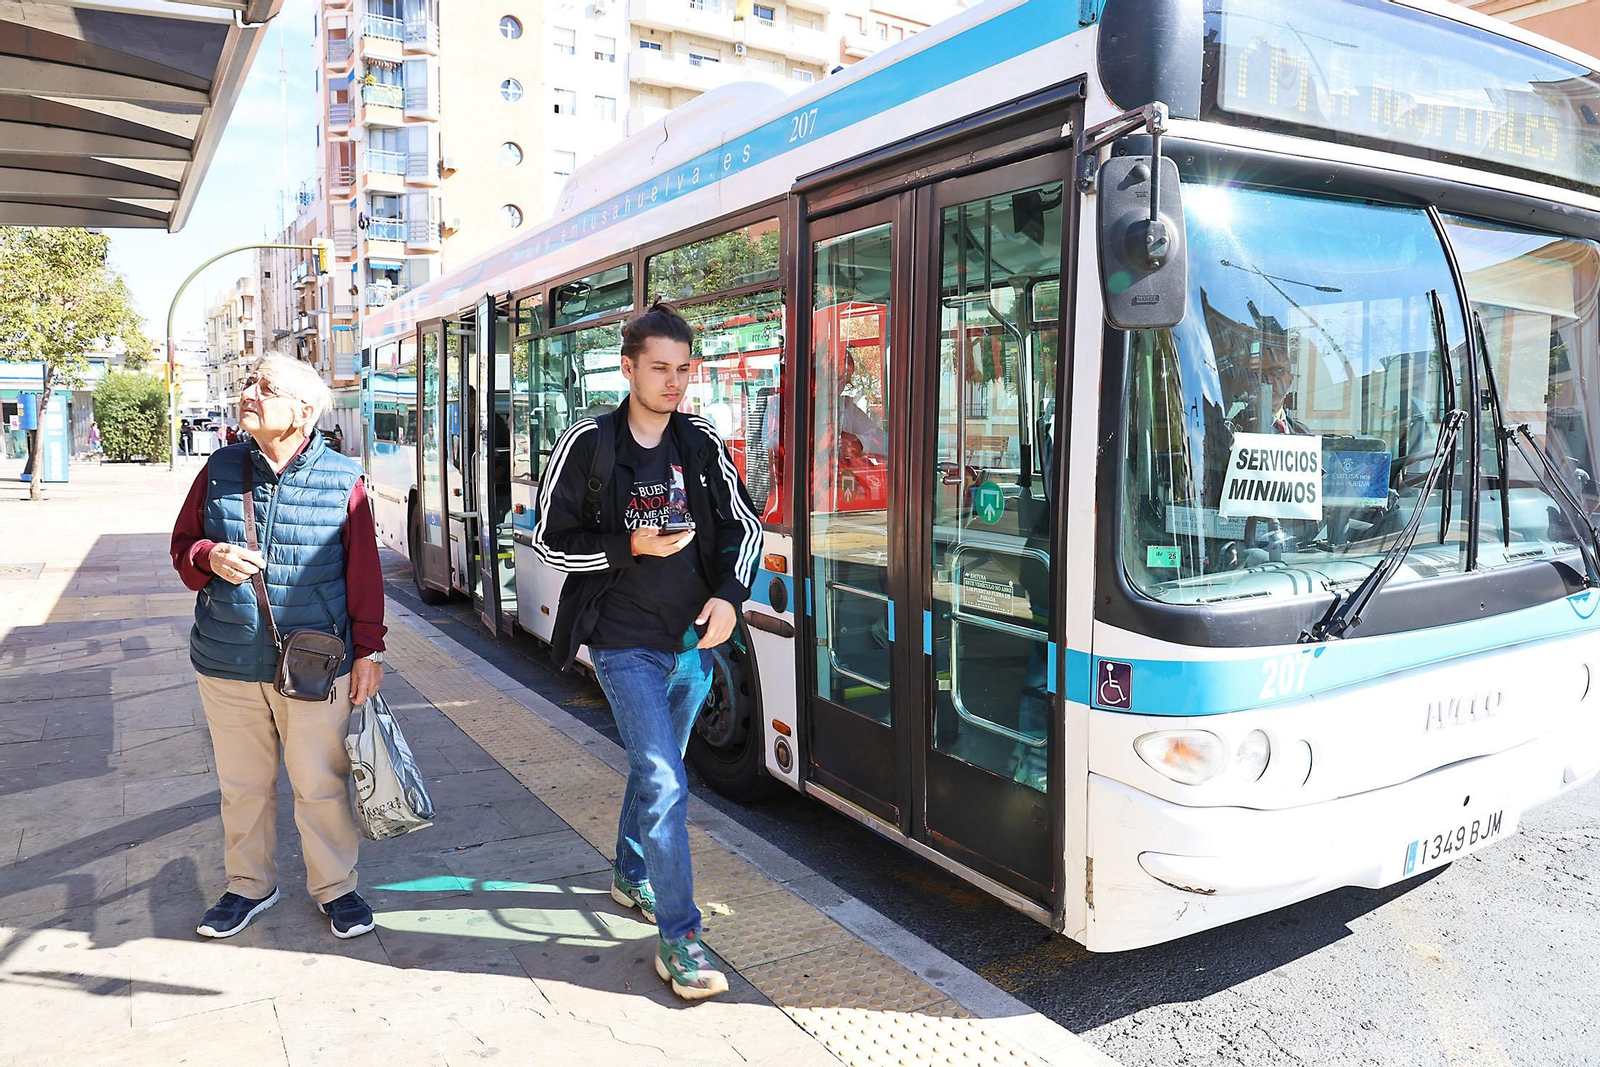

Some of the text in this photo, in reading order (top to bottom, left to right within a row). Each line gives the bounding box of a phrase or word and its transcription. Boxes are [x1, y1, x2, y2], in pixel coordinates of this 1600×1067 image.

[789, 107, 819, 143] 207
[1235, 448, 1318, 473] SERVICIOS
[1228, 478, 1317, 504] MINIMOS
[1259, 655, 1310, 700] 207
[1421, 810, 1503, 865] 1349 BJM
